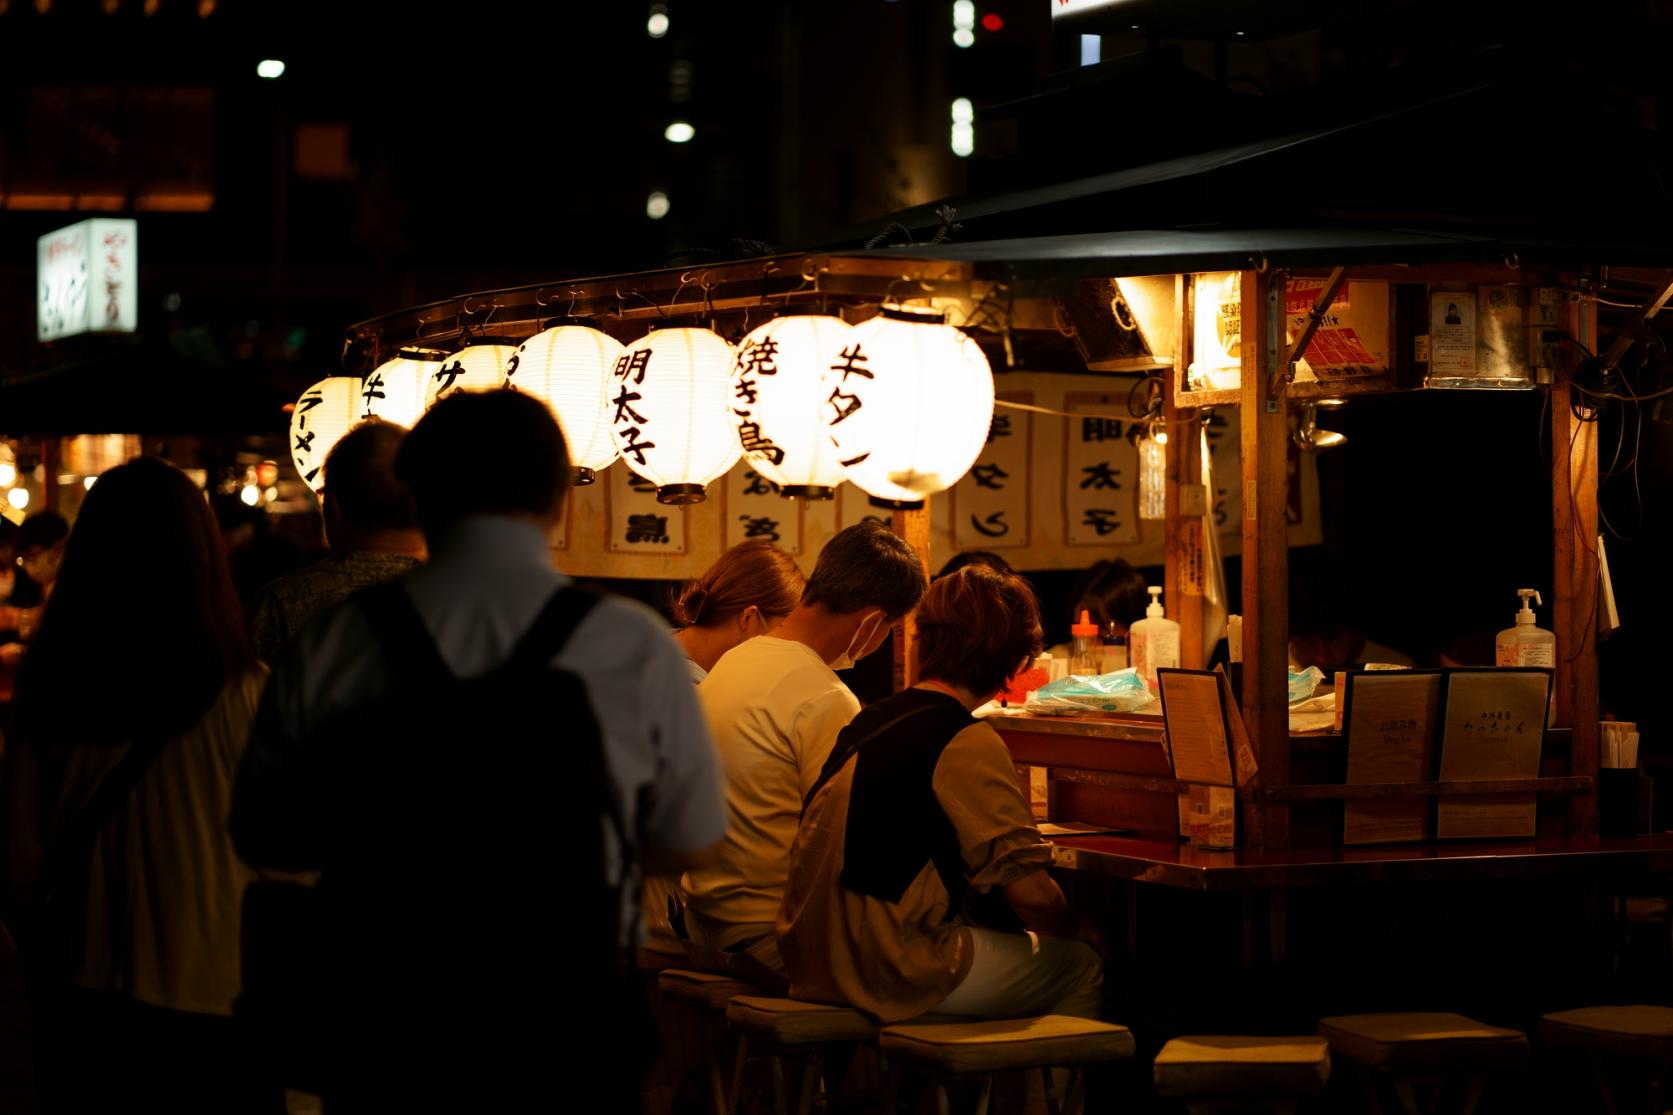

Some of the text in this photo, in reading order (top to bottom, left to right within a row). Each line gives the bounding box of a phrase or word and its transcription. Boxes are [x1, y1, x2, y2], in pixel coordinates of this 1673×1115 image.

[294, 389, 324, 484] ラーメン
[612, 347, 656, 466] 明太子
[732, 336, 786, 466] 焼き鳥
[829, 343, 875, 467] 牛タン
